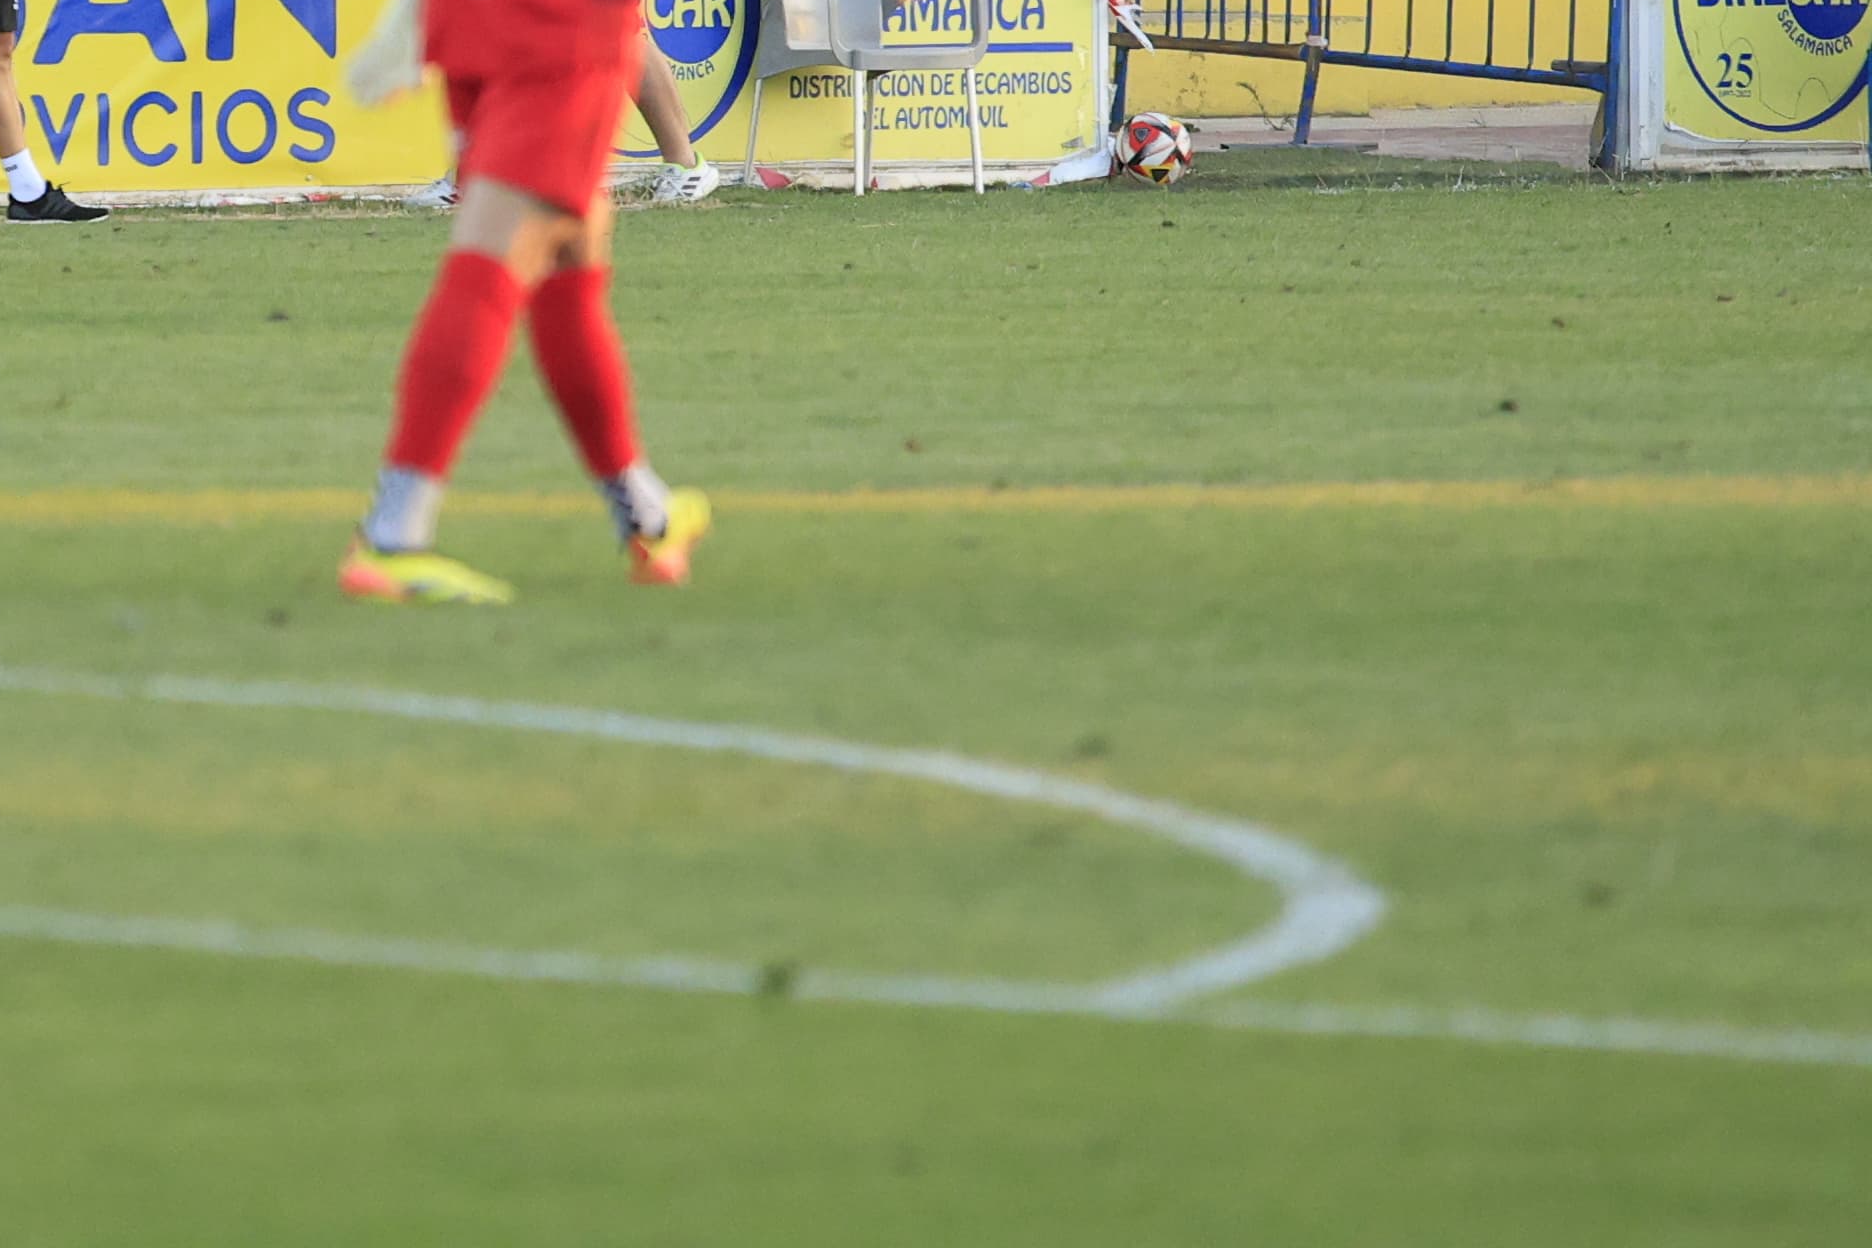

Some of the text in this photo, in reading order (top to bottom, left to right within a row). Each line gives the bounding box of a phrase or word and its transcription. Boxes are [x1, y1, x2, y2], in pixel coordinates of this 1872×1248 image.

[1777, 8, 1854, 56] SALAMANCA
[931, 73, 954, 95] DE
[1715, 52, 1753, 89] 25
